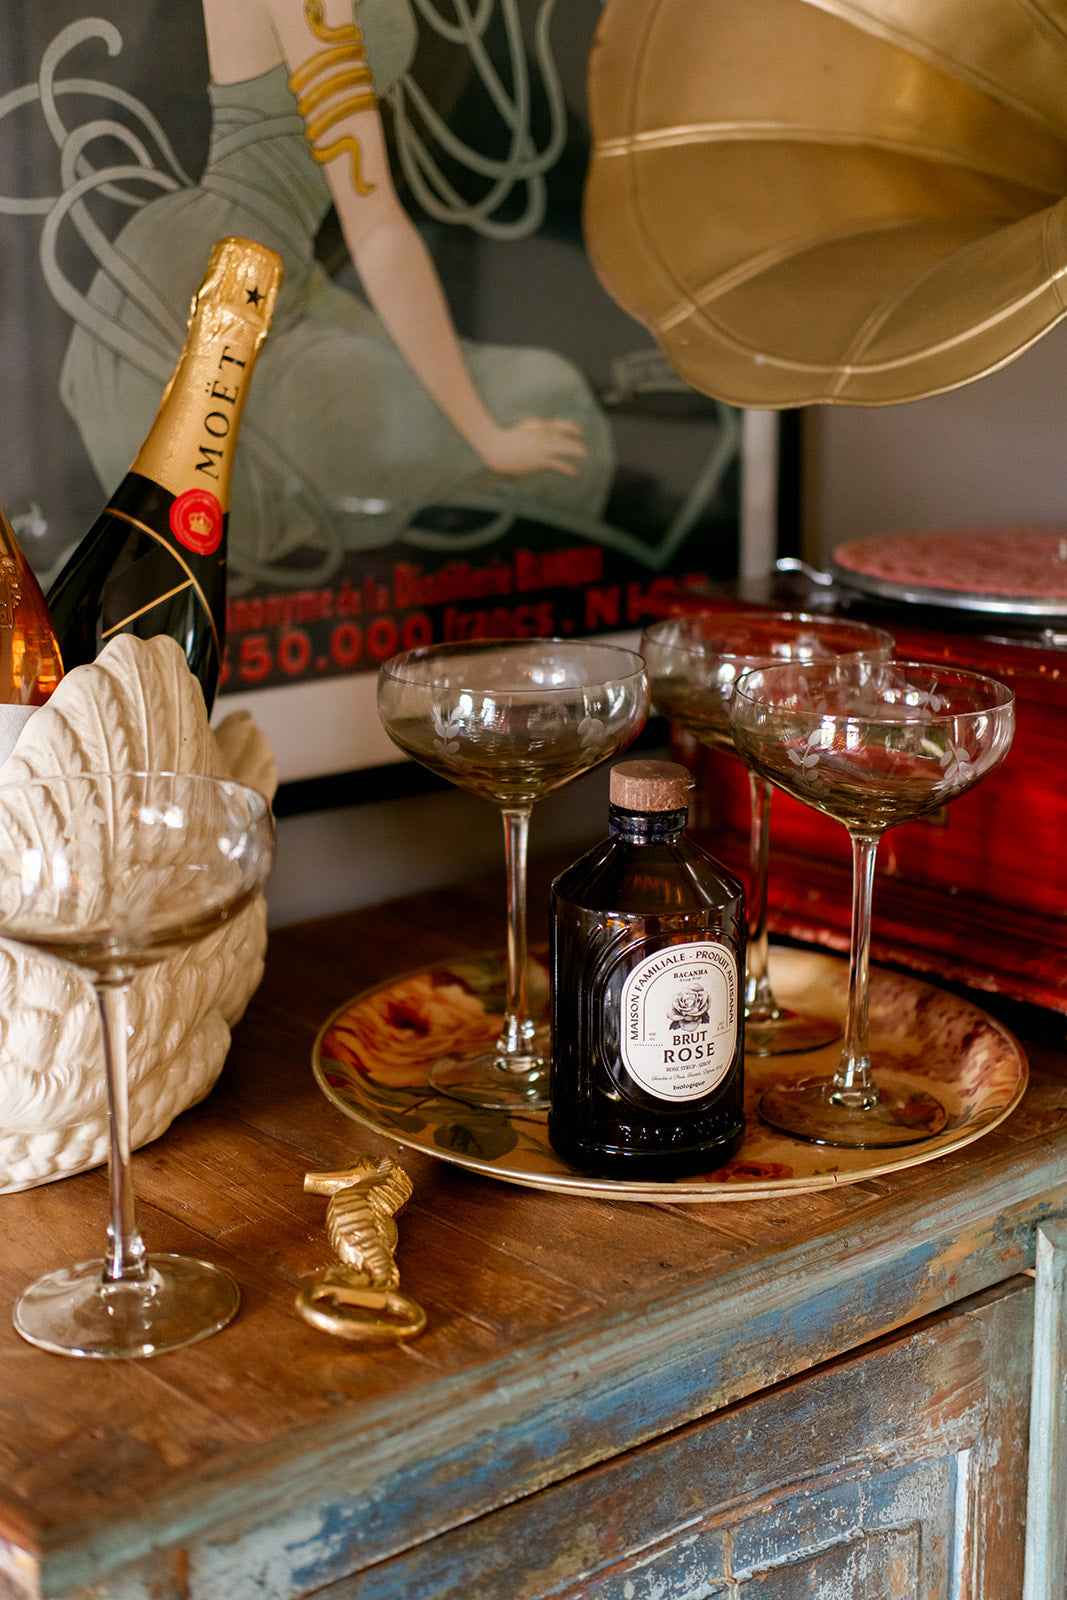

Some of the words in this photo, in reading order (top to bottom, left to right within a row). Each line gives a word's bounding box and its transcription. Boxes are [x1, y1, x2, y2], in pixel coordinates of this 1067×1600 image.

[195, 346, 246, 479] MOËT
[630, 994, 640, 1041] MAISON
[635, 953, 686, 992] FAMILIALE
[695, 950, 730, 970] PRODUIT
[664, 1042, 715, 1063] ROSE
[673, 1030, 708, 1046] BRUT
